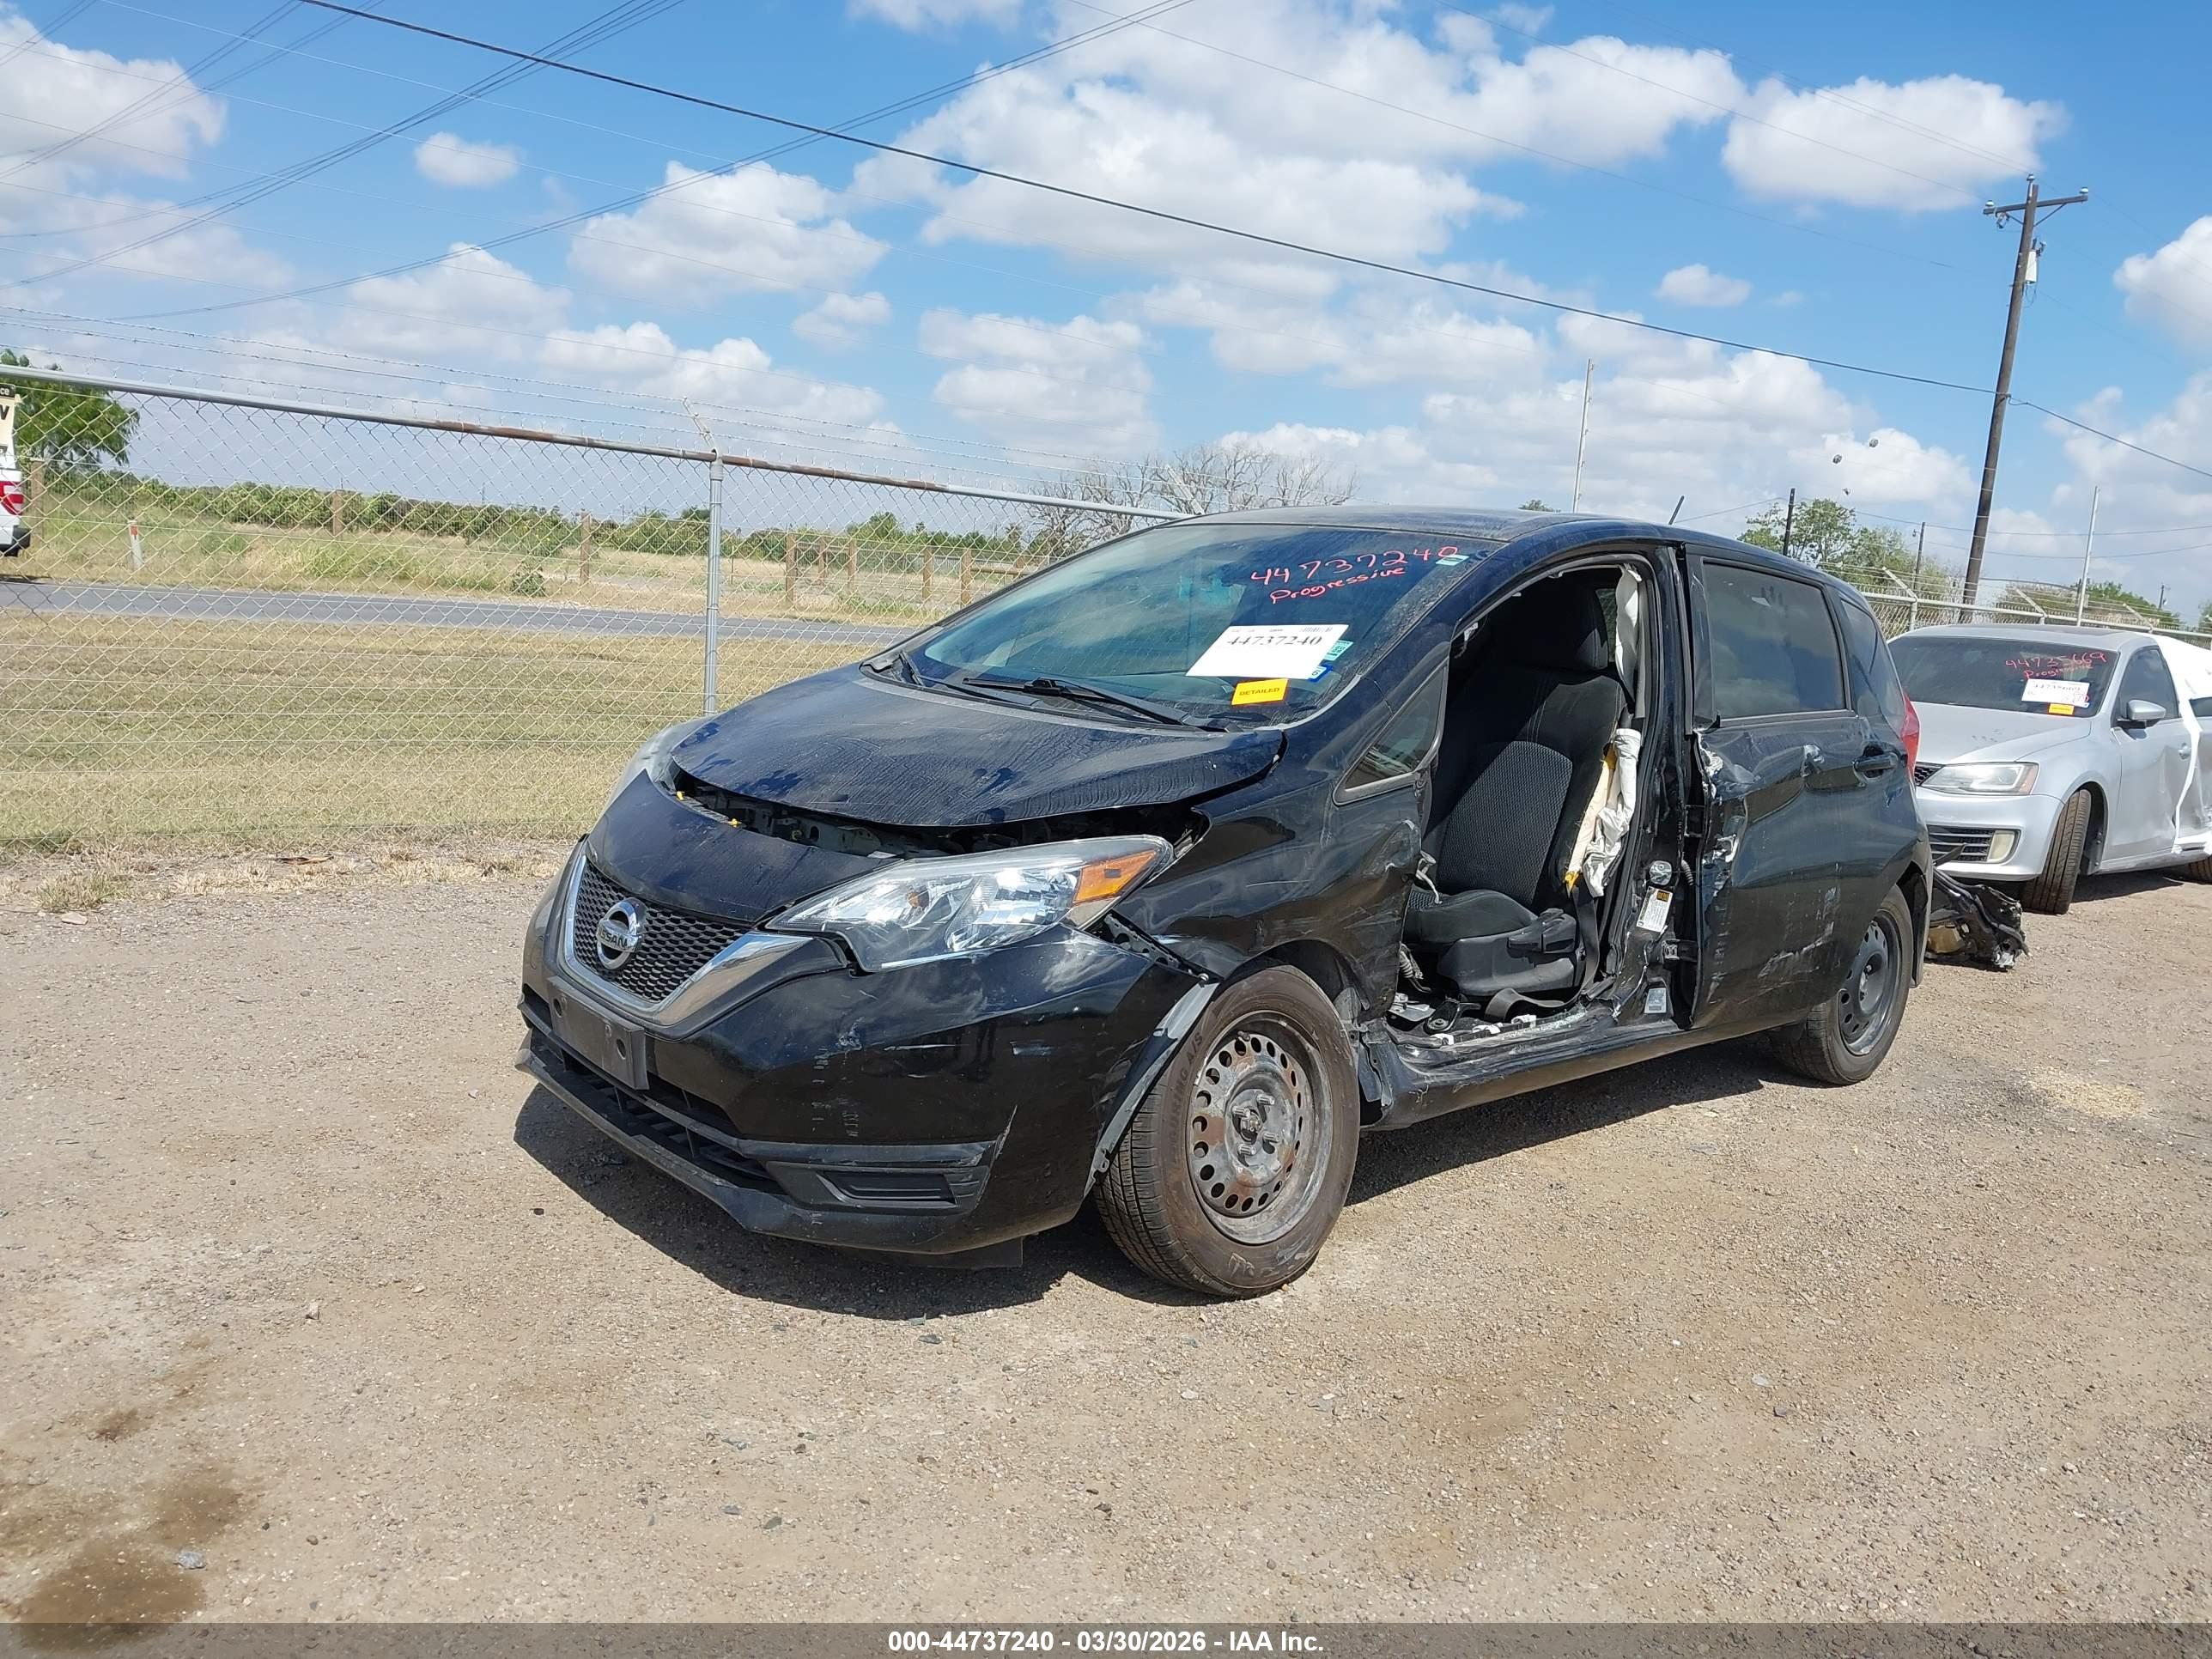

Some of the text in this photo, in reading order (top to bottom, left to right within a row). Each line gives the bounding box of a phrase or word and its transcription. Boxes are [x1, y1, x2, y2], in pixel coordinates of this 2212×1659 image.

[1251, 546, 1458, 585] 44737240
[1226, 635, 1322, 646] 44737240
[1239, 687, 1280, 696] DETAILED
